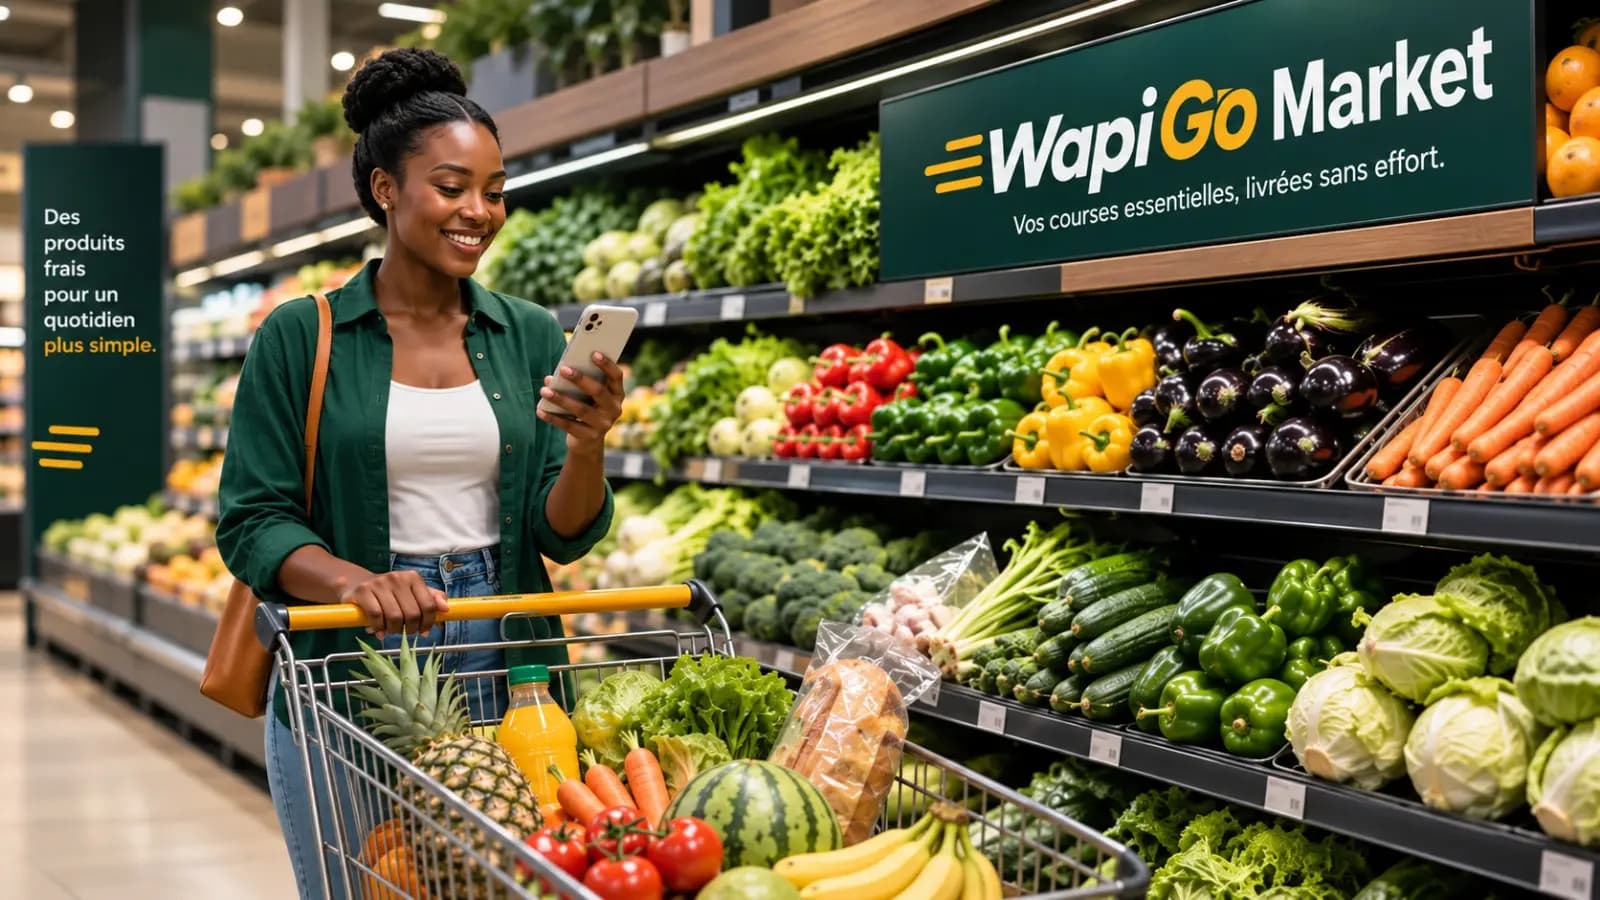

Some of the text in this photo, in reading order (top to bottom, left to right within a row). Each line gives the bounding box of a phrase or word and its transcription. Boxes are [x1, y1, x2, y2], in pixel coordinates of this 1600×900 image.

[1274, 27, 1493, 140] Market
[1013, 145, 1445, 234] Vos courses essentielles, livrées sans effort.
[44, 208, 81, 225] Des
[44, 233, 125, 255] produits
[43, 259, 86, 277] frais
[44, 289, 119, 307] pour un
[43, 311, 136, 332] quotidien
[44, 336, 156, 357] plus simple.
